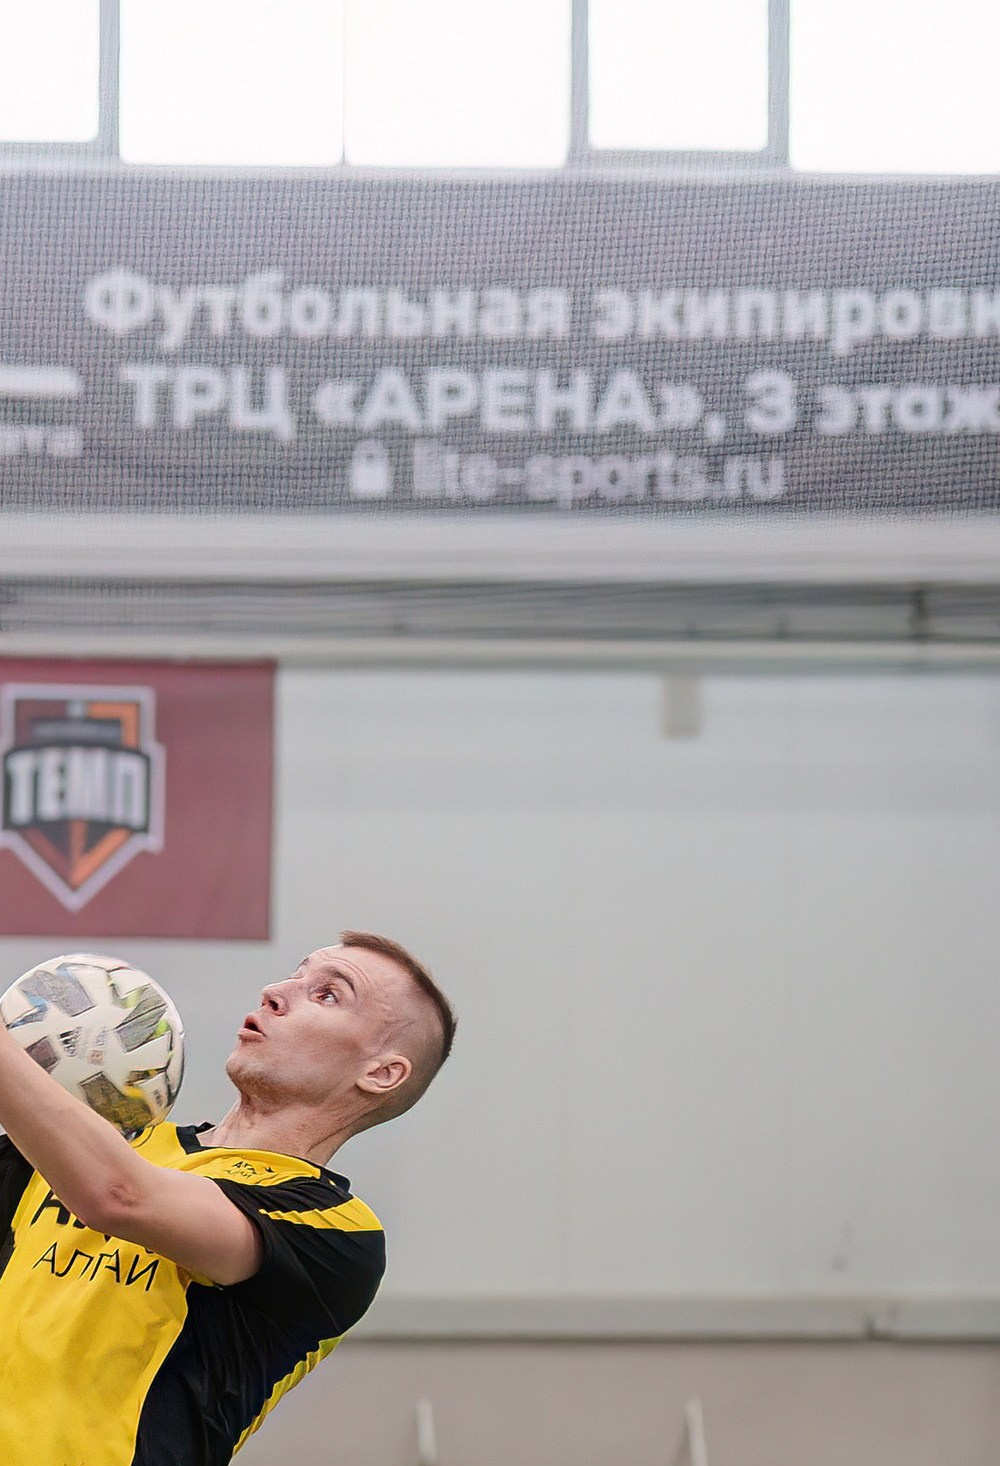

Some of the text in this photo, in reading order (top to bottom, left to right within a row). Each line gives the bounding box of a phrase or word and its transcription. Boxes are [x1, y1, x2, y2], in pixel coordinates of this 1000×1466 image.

[84, 265, 569, 350] Футбольная
[120, 364, 1000, 442] ТРЦ «АРЕНА», 3 этаж
[414, 446, 785, 508] lite-sports.ru
[7, 746, 147, 826] ТЕМП
